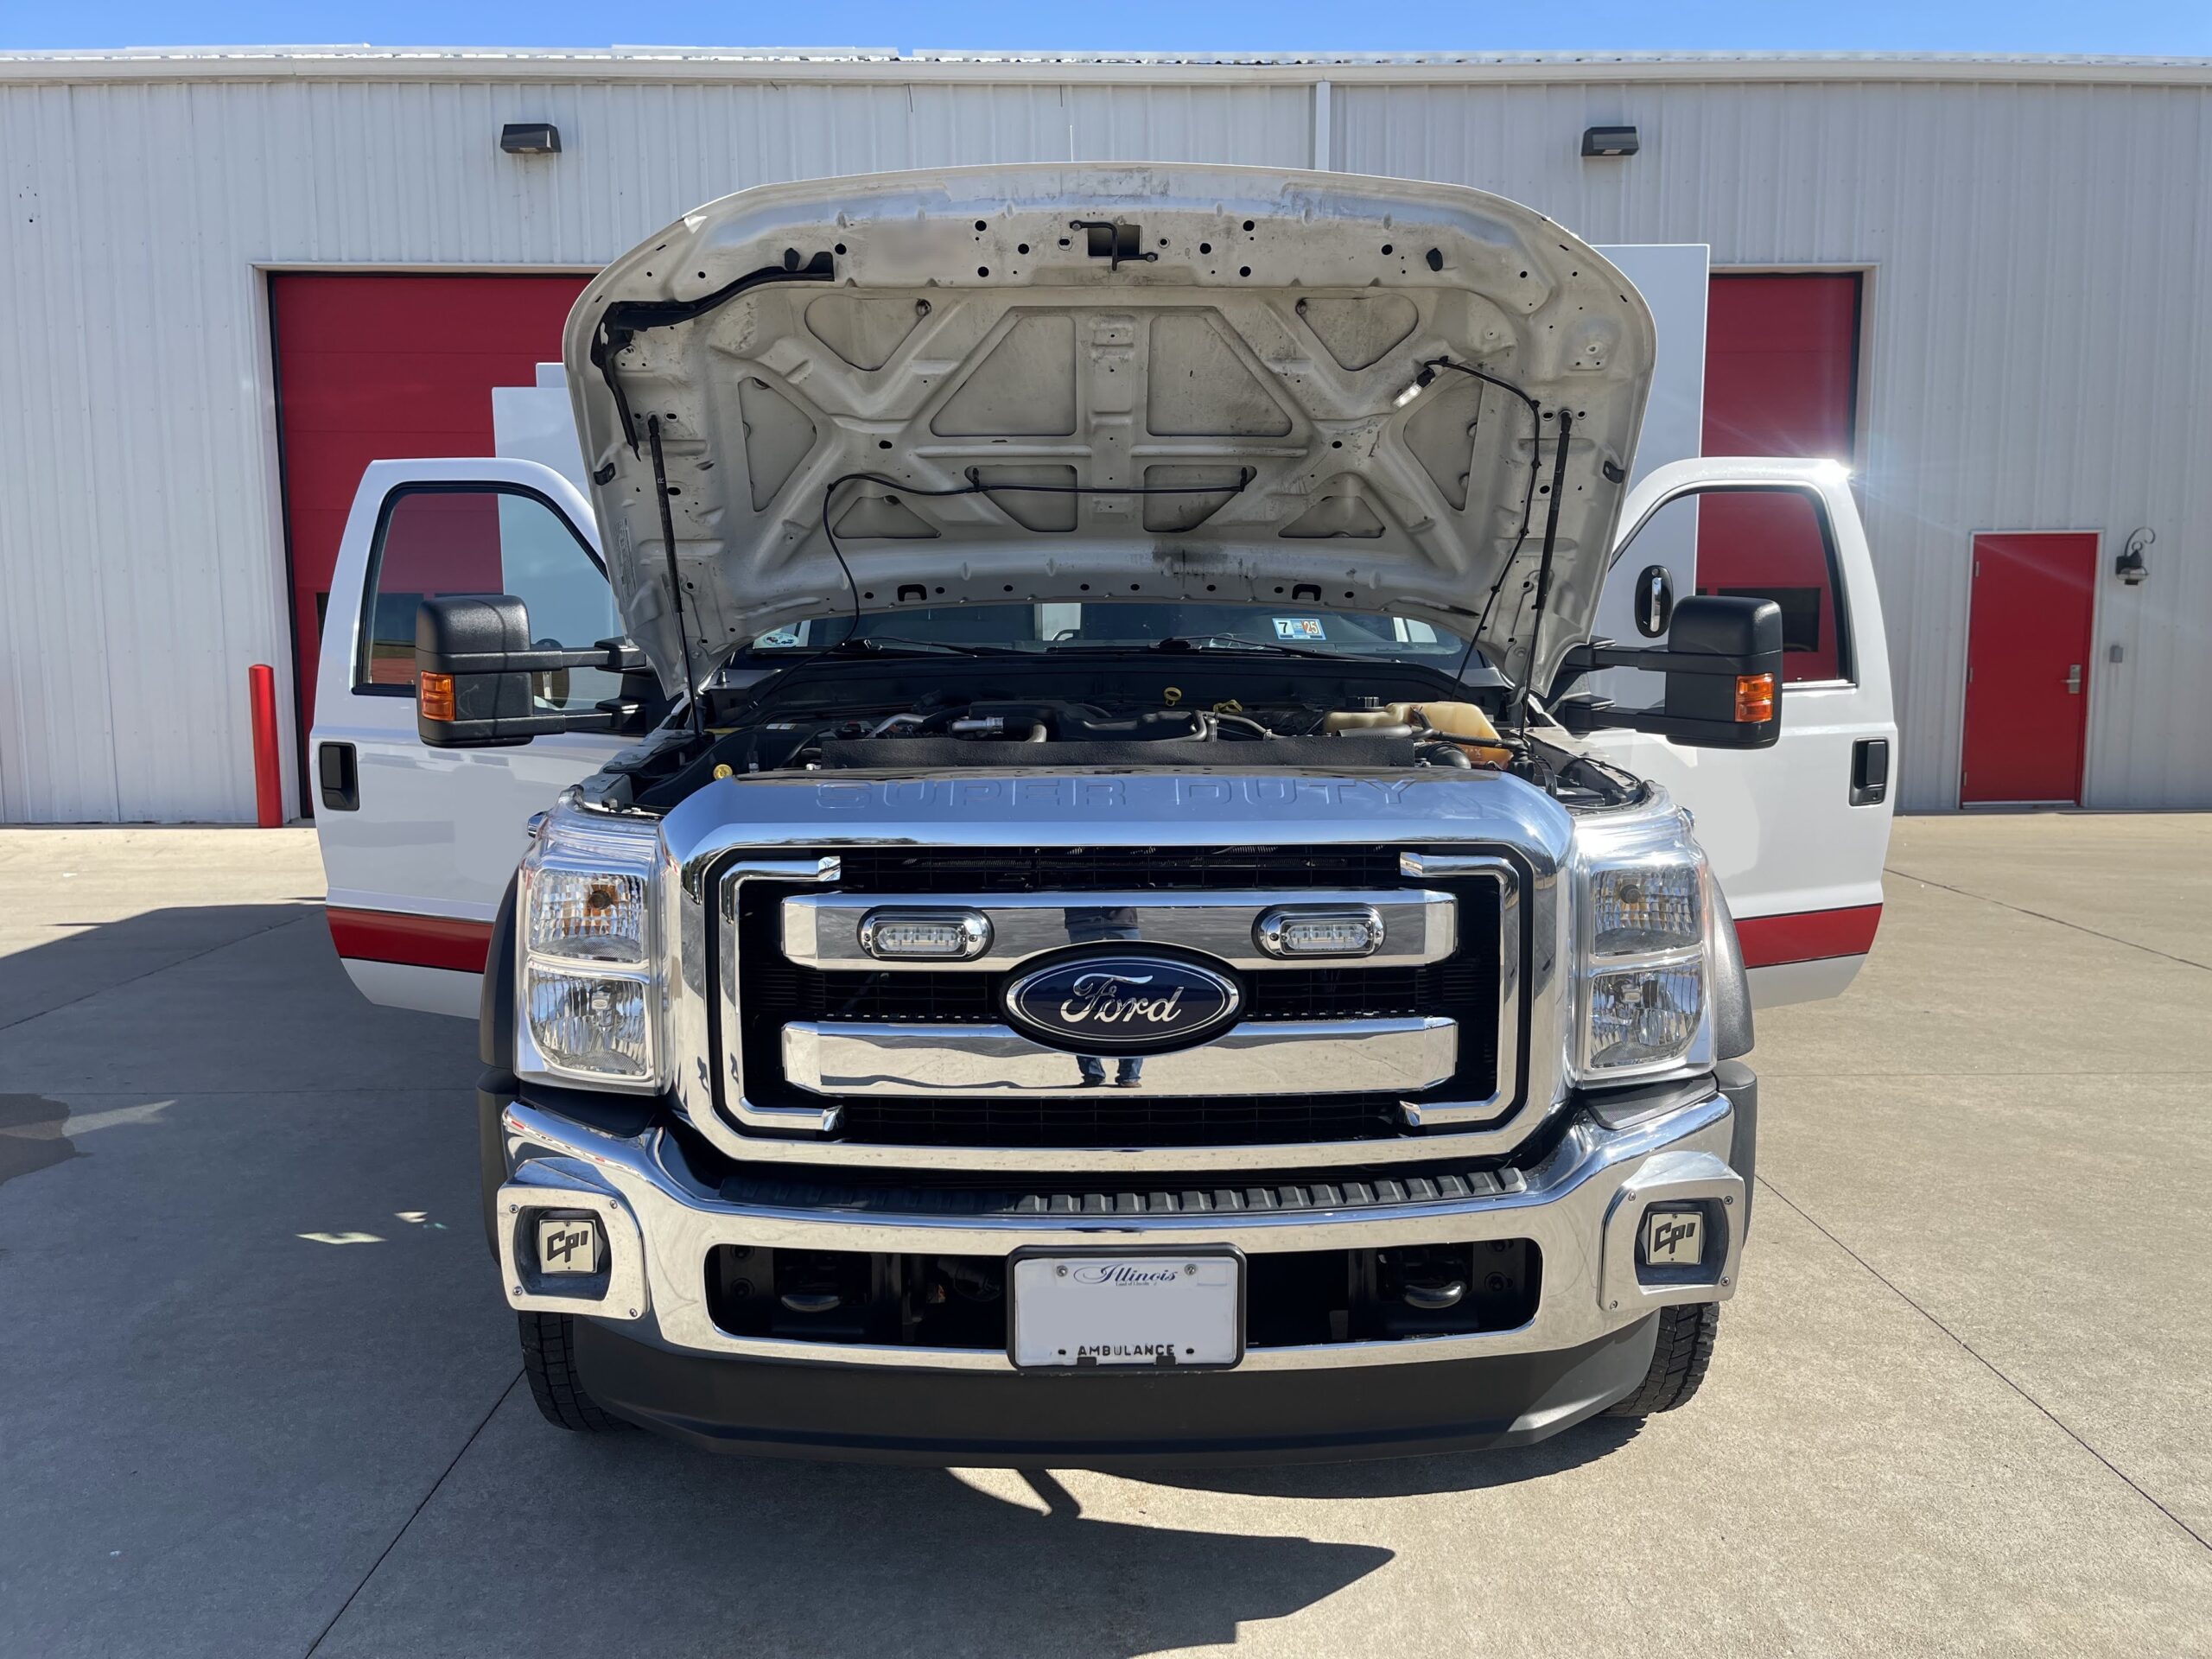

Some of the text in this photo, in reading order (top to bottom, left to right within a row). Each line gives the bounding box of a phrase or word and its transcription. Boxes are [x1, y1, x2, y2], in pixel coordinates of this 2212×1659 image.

[1278, 620, 1319, 634] 7 25
[816, 778, 1417, 808] SUPER DUTY
[1060, 972, 1185, 1023] Ford
[1073, 1263, 1179, 1284] Illinois
[1077, 1344, 1175, 1357] AMBULANCE
